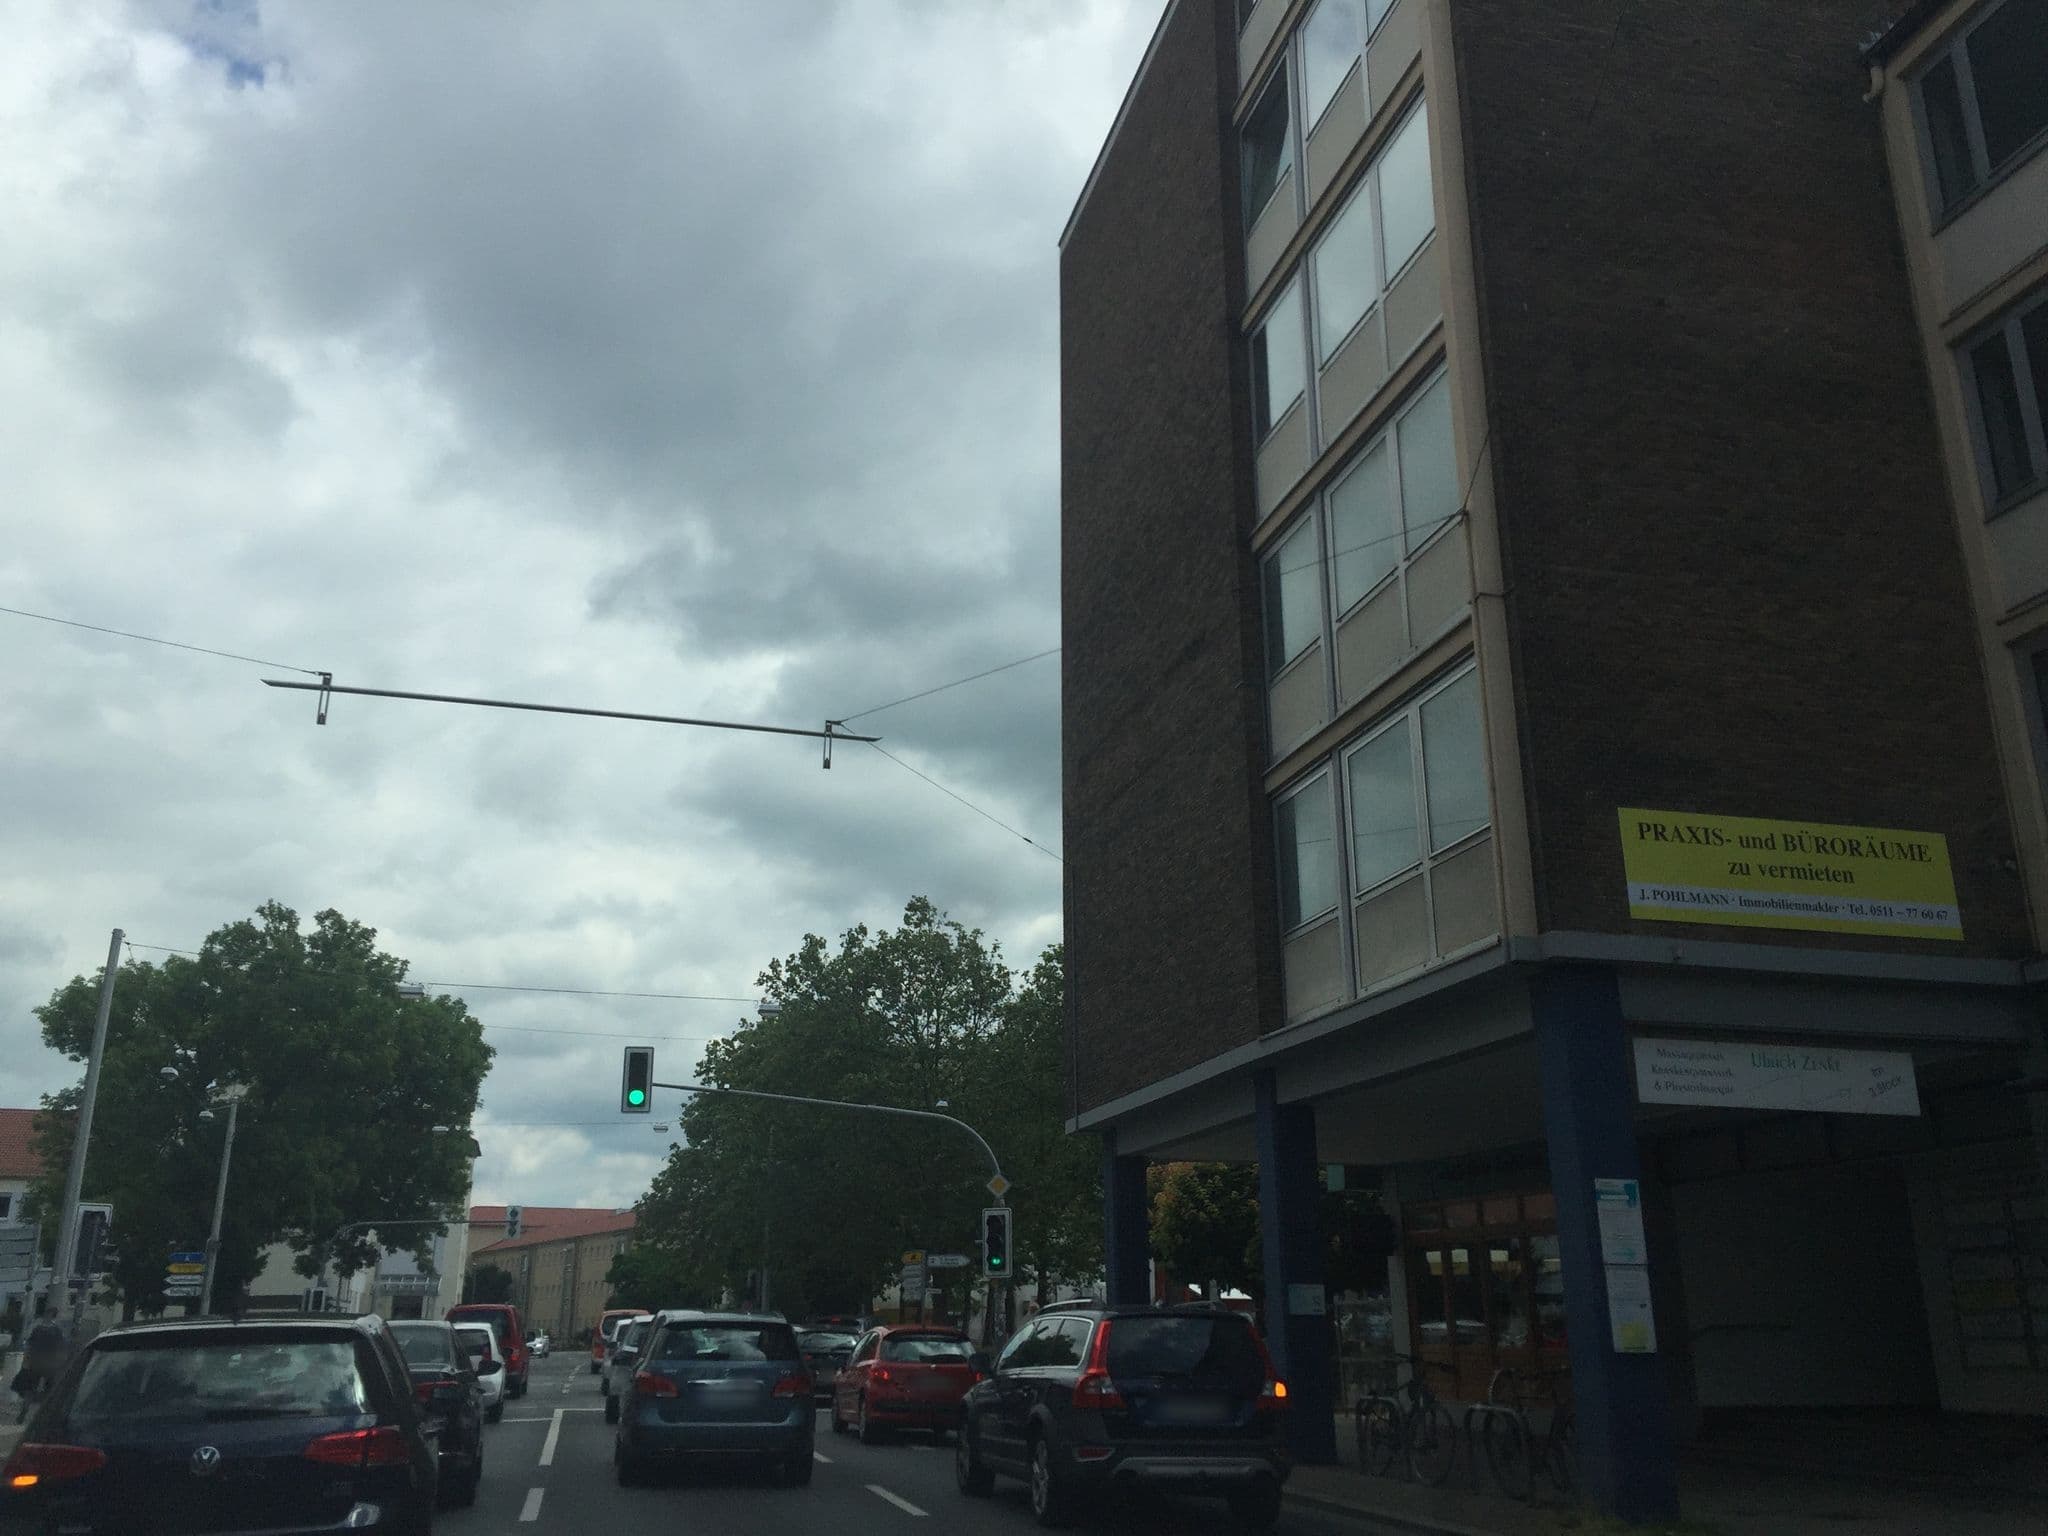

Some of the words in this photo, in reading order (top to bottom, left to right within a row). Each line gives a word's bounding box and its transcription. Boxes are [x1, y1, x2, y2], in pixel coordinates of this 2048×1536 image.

[1638, 822, 1732, 846] PRAXIS-
[1739, 833, 1777, 851] und
[1783, 830, 1932, 862] BÜRORÄUME
[1728, 862, 1751, 876] zu
[1758, 863, 1855, 884] vermieten
[1639, 888, 1650, 901] J.
[1652, 889, 1730, 905] POHLMANN
[1738, 895, 1840, 913] Immobilienmakler
[1848, 903, 1868, 916] Tel.
[1870, 905, 1894, 917] 0511
